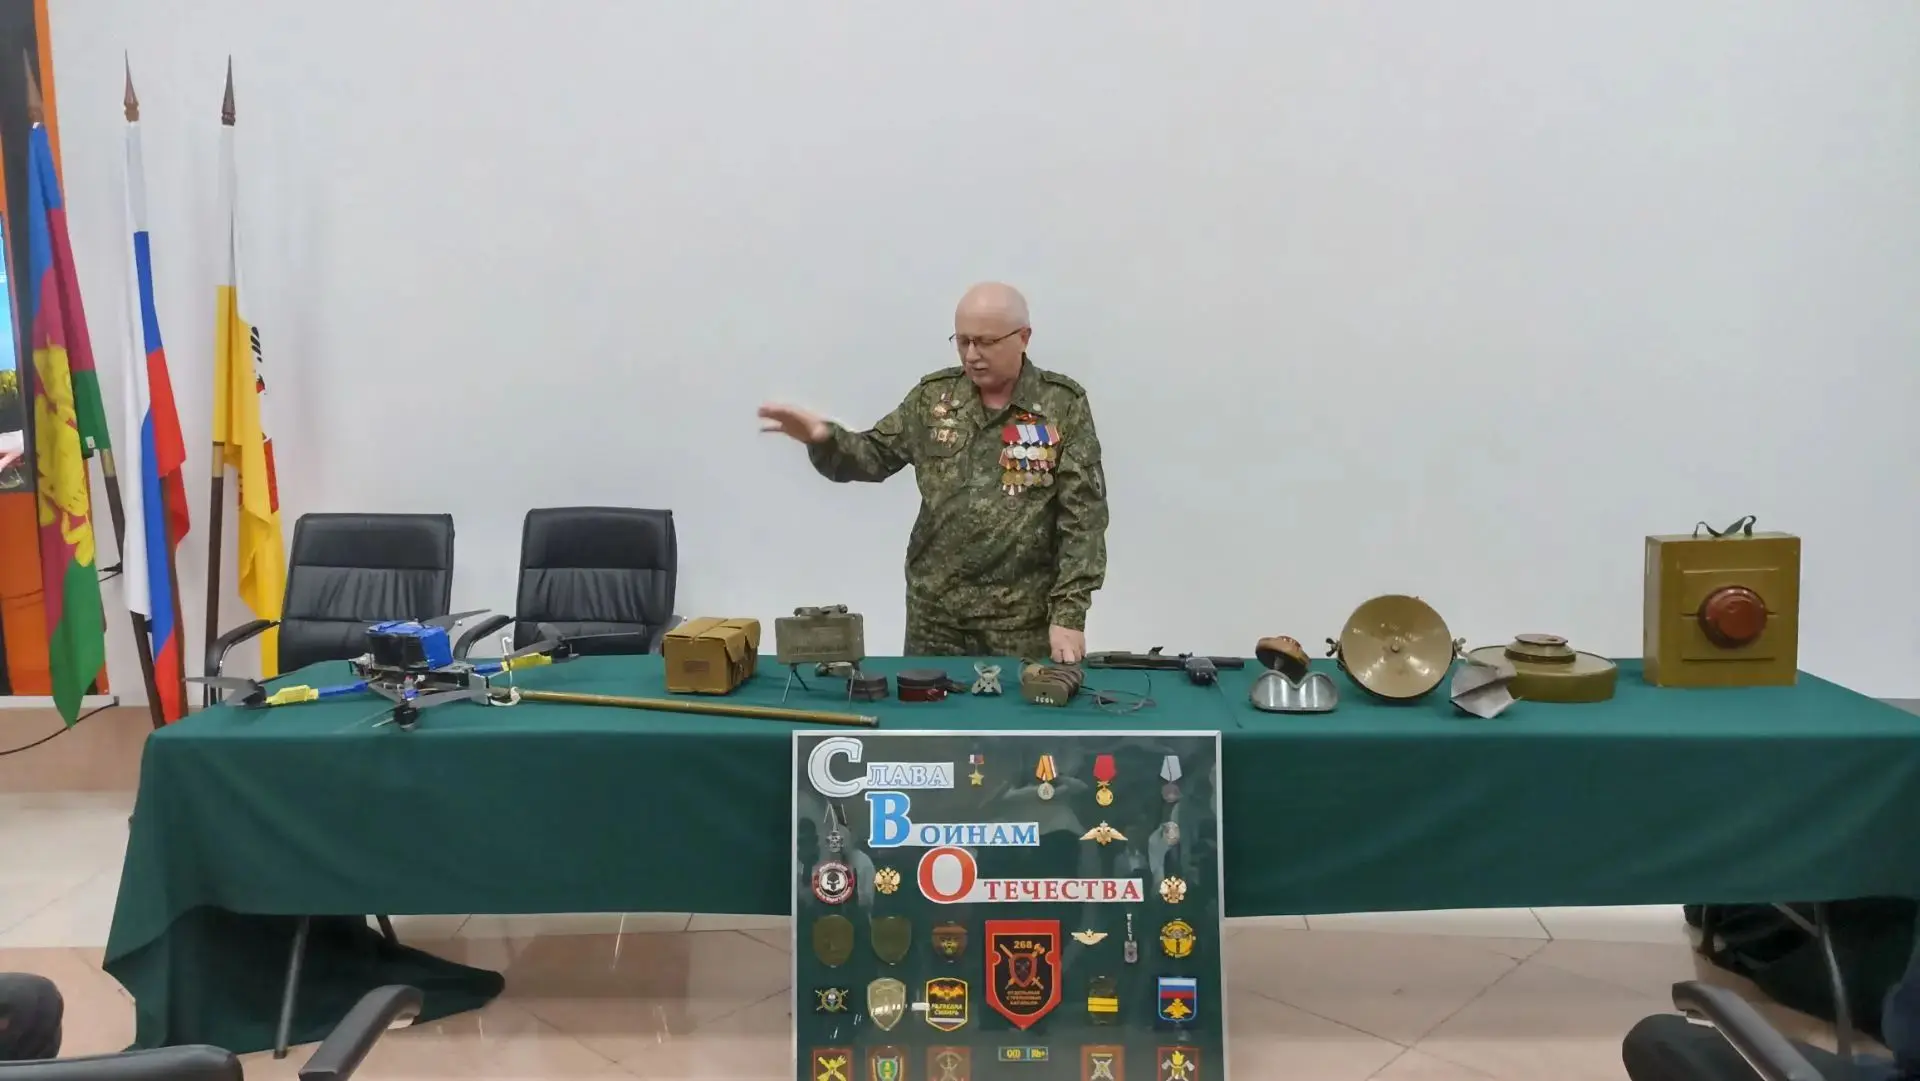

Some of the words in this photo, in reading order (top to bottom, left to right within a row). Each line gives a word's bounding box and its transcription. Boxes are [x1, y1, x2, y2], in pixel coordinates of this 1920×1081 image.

[809, 738, 949, 796] СЛАВА
[867, 793, 1037, 846] ВОИНАМ
[918, 847, 1143, 903] ОТЕЧЕСТВА
[1013, 941, 1033, 949] 268
